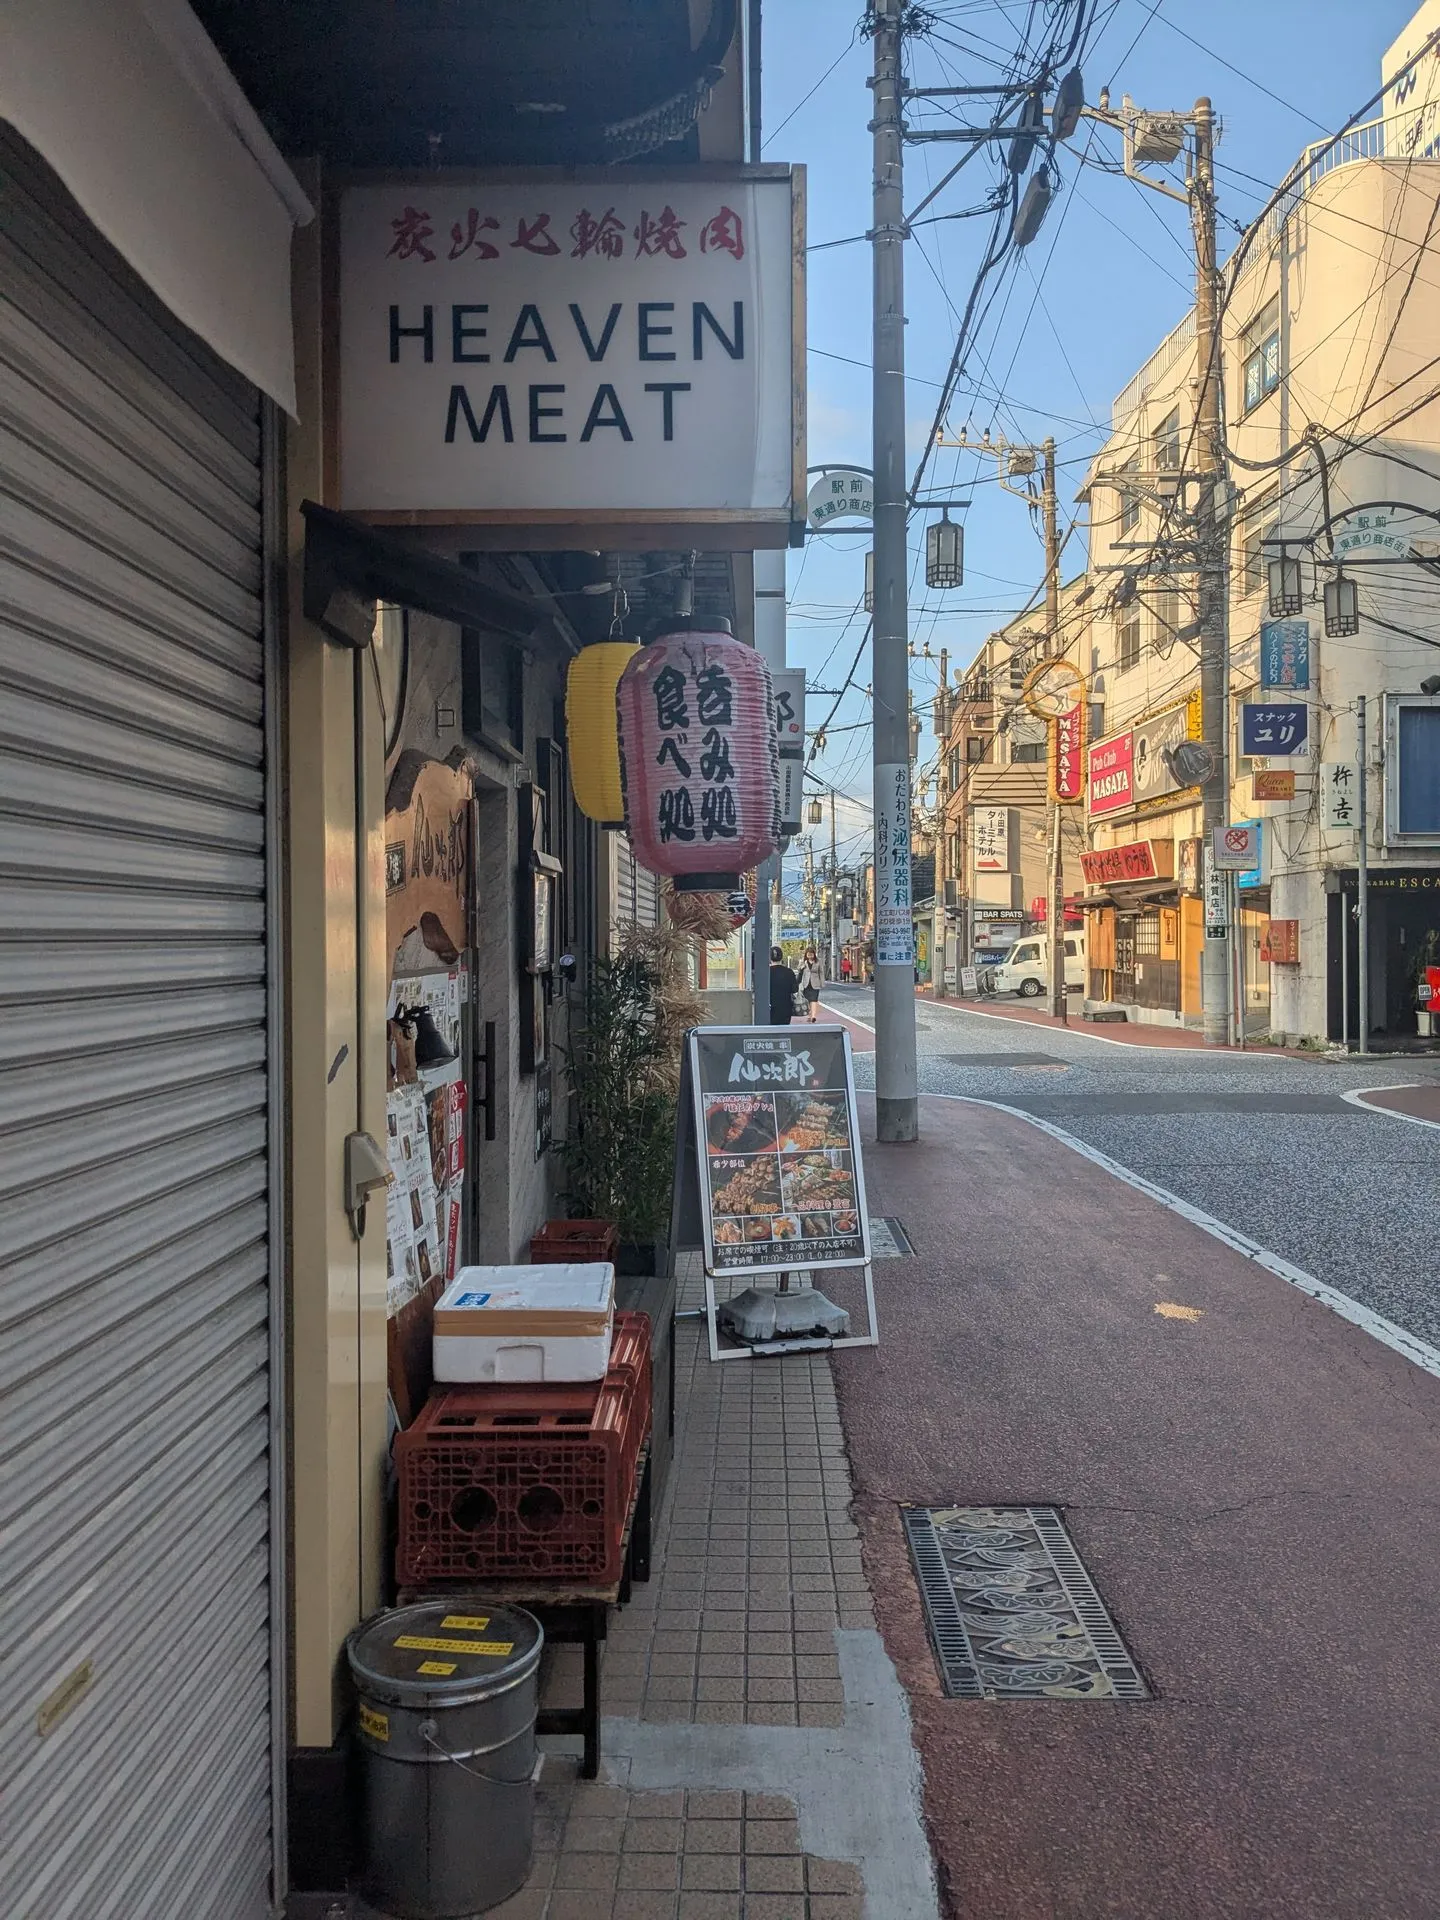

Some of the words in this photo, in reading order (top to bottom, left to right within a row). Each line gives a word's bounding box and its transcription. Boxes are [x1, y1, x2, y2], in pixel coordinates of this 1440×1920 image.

[385, 204, 745, 263] 炭火七輪焼肉
[389, 301, 745, 363] HEAVEN
[444, 382, 692, 443] MEAT
[831, 479, 863, 494] 駅前
[1357, 515, 1387, 528] 駅前
[1297, 627, 1307, 664] スナック
[1253, 712, 1297, 723] スナック
[1254, 725, 1296, 745] ユリ
[653, 665, 696, 844] 食べ処
[1058, 718, 1071, 792] MASAYA
[1092, 755, 1104, 773] Pub
[1103, 749, 1117, 768] Club
[1093, 769, 1129, 801] MASAYA
[987, 810, 996, 856] ターミナル
[997, 810, 1005, 837] 小田原
[978, 825, 987, 856] ホテル
[1419, 985, 1431, 994] OPEN
[728, 1050, 815, 1087] 仙次郎
[712, 1159, 746, 1169] 希少部位
